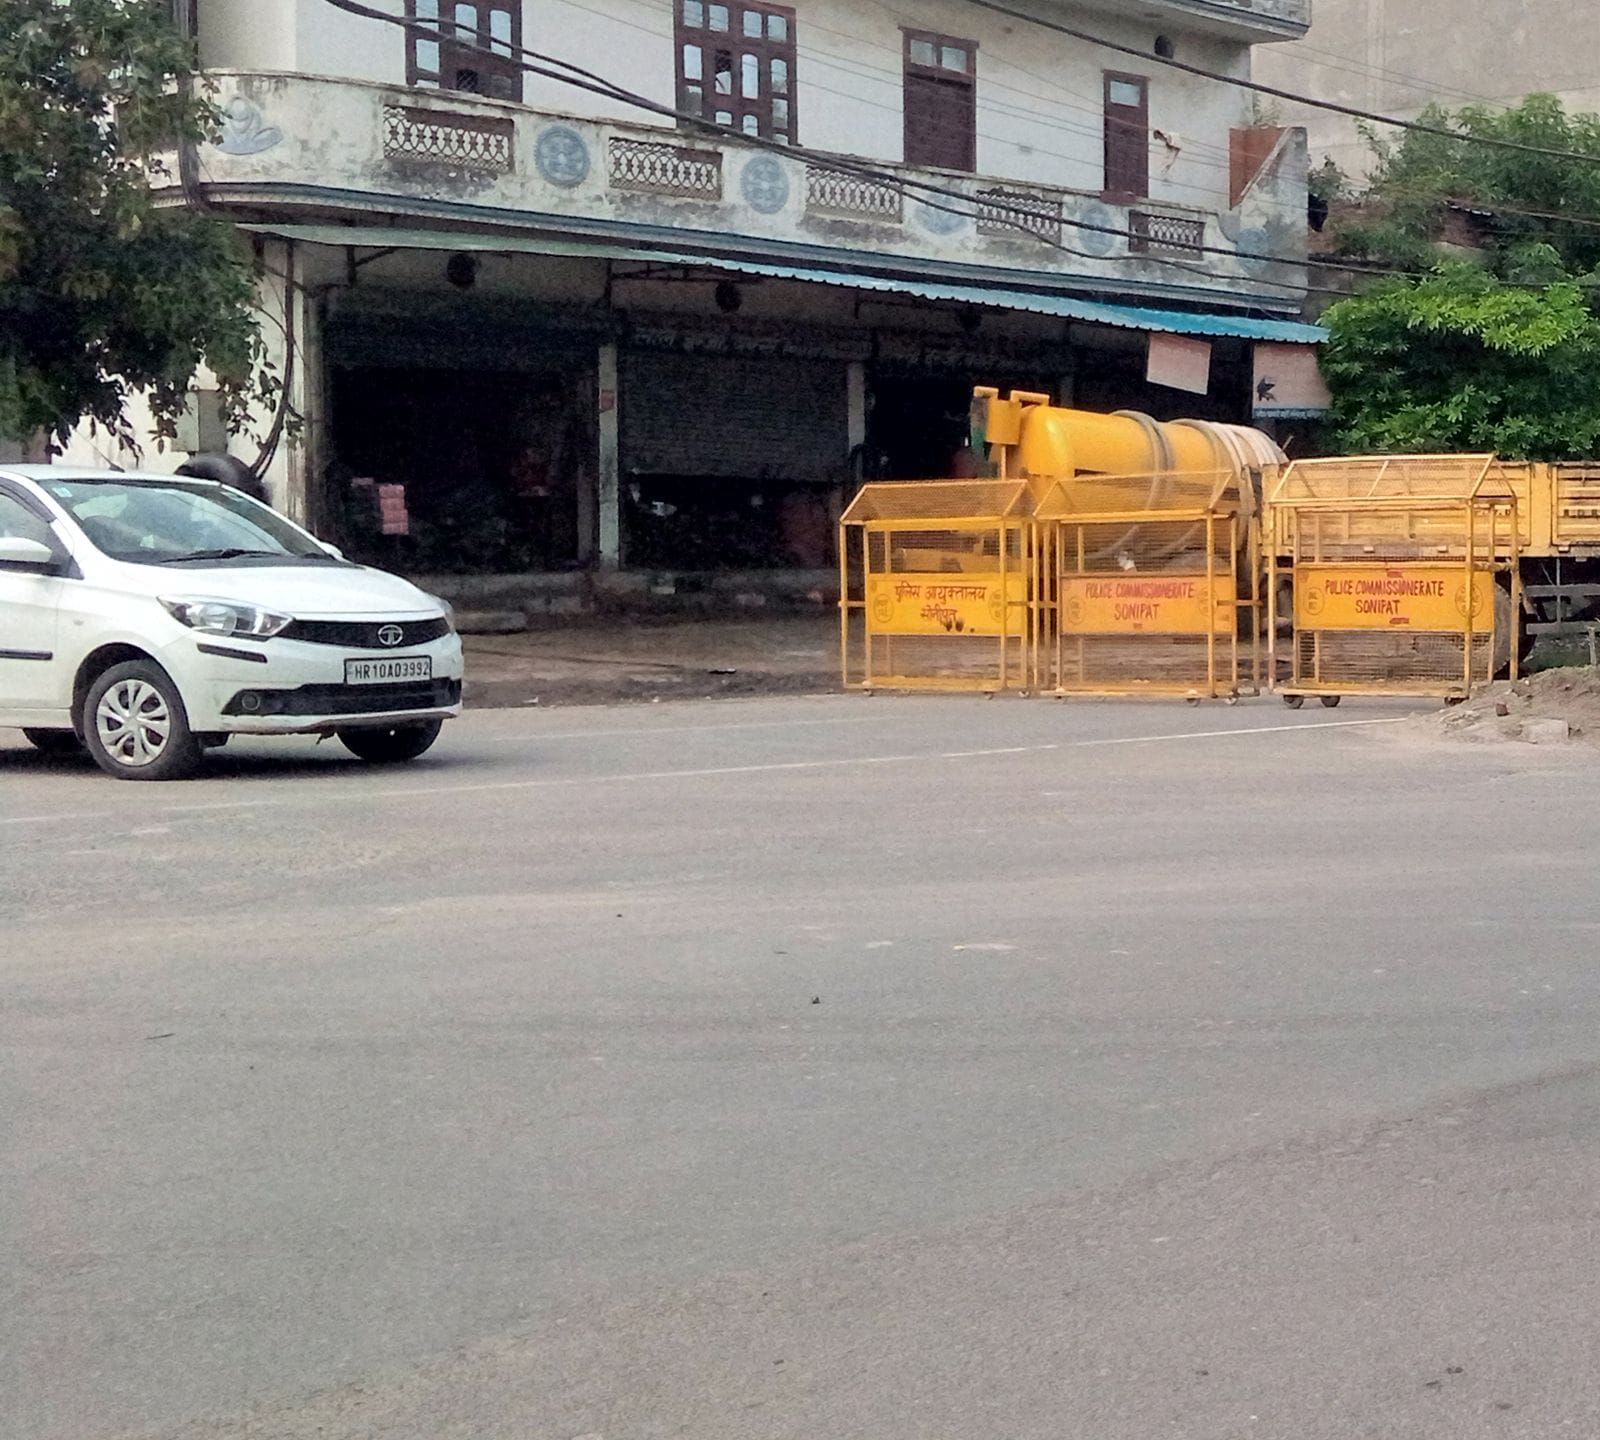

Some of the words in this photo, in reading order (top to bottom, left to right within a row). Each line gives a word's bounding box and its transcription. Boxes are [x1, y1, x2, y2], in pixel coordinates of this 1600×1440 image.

[895, 580, 921, 603] पुलिस
[1085, 582, 1113, 599] POLICE
[1325, 579, 1353, 596] POLICE
[1355, 579, 1444, 597] COMMISSIONERATE
[1114, 603, 1160, 621] SONIPAT
[1355, 600, 1400, 615] SONIPAT
[354, 662, 430, 679] HR10AD3992
